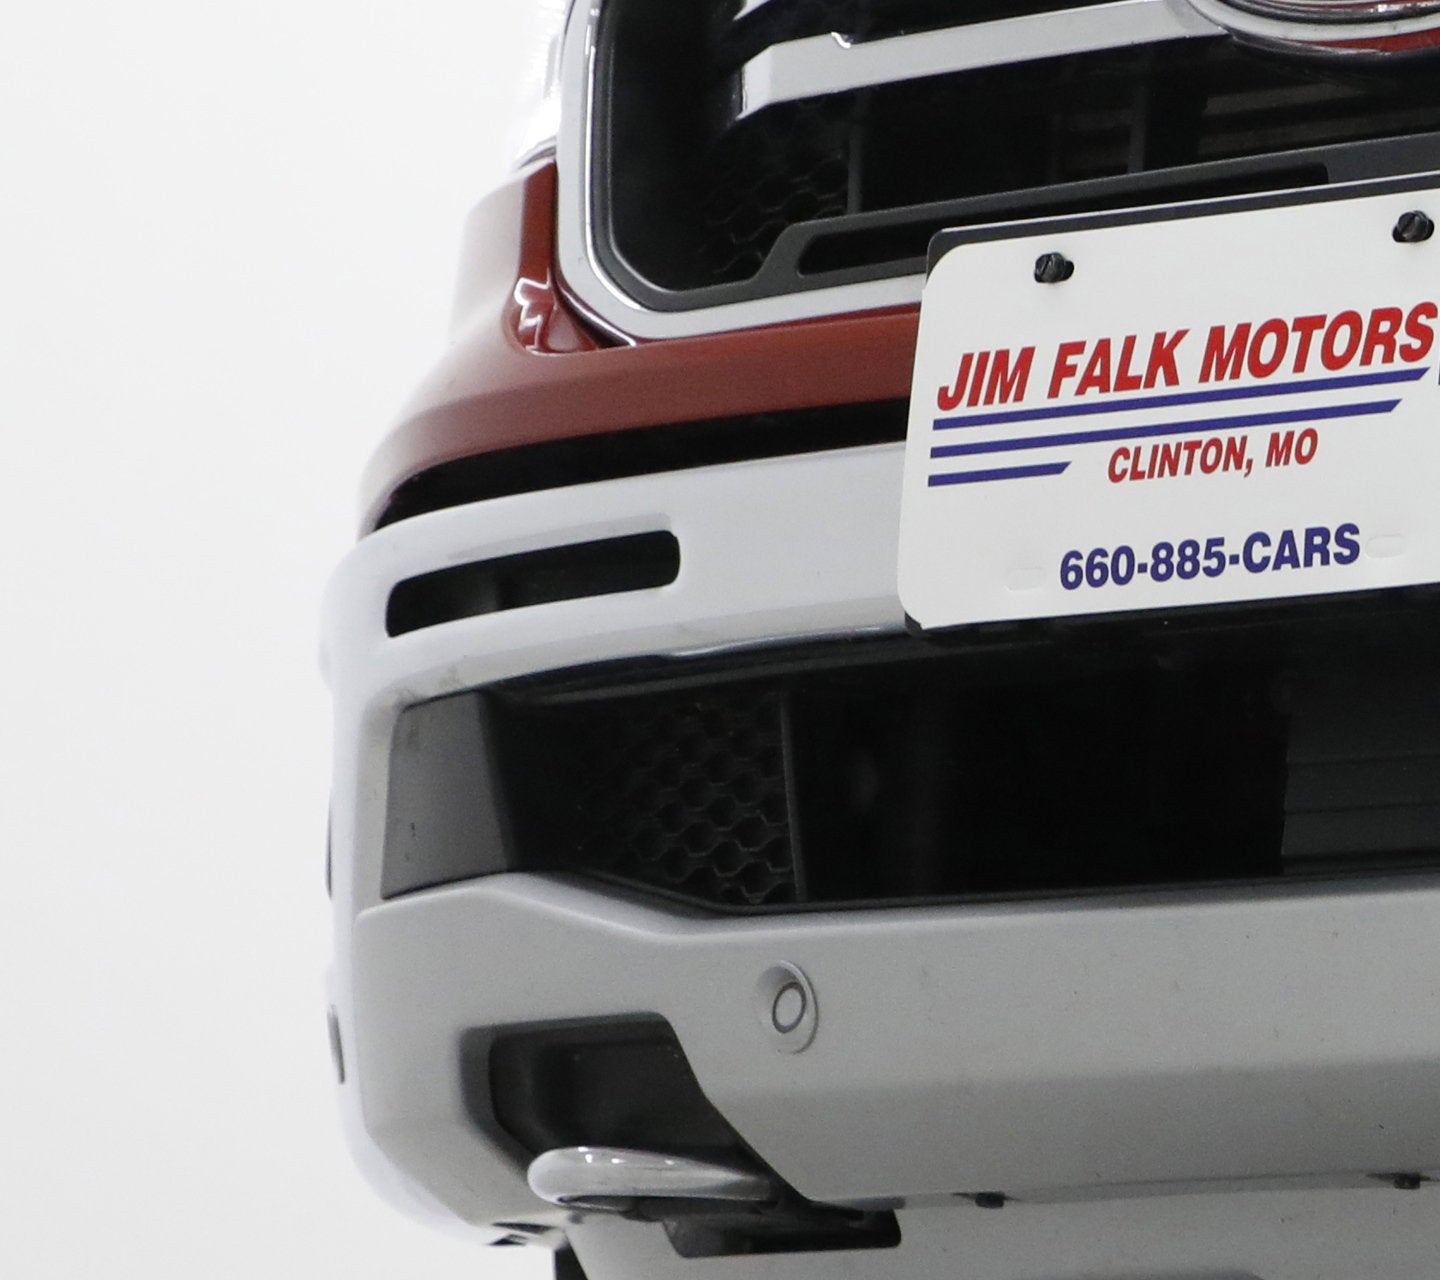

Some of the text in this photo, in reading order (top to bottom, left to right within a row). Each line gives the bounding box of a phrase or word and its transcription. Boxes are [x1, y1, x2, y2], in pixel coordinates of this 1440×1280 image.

[937, 301, 1438, 411] JIM FALK MOTORS
[1108, 428, 1318, 484] CLINTON, MO
[1061, 522, 1360, 590] 660-885-CARS
